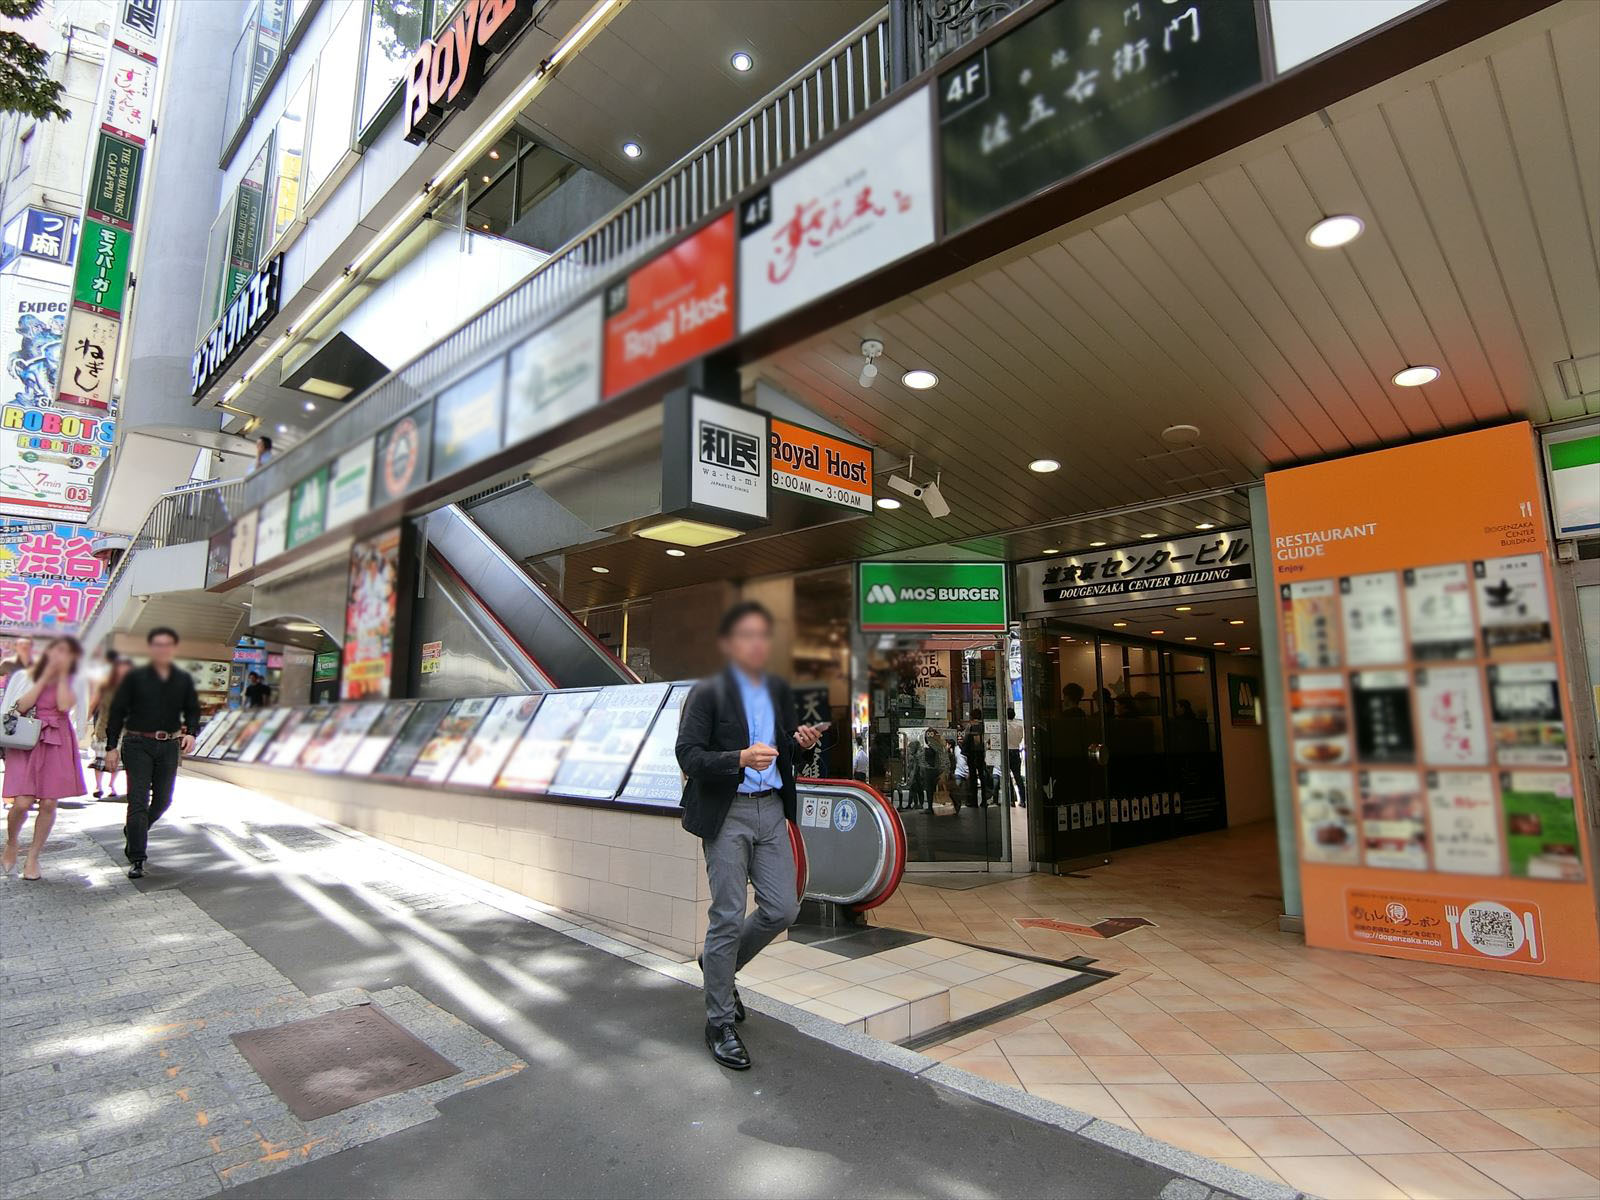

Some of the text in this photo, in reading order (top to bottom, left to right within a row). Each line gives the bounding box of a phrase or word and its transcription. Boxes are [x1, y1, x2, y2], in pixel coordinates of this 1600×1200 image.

[125, 0, 157, 36] 民
[947, 64, 980, 103] 4F
[121, 147, 132, 165] THE
[744, 197, 769, 226] 4F
[92, 228, 117, 304] モスバーガー
[91, 305, 104, 313] 1F
[74, 337, 105, 392] ねぎし
[18, 434, 71, 453] ROBOT
[702, 427, 757, 473] 和民
[771, 431, 868, 485] Royal Host
[36, 473, 49, 486] 7
[772, 472, 798, 487] 9:00
[800, 482, 811, 494] AM
[826, 485, 849, 503] 3:00
[850, 494, 861, 507] AM
[1276, 523, 1377, 548] RESTAURANT
[1484, 521, 1534, 534] DOGENZAKA
[1505, 528, 1535, 539] CENTER
[1277, 544, 1326, 561] GUIDE
[1501, 537, 1537, 547] BUILDING
[17, 534, 102, 578] 渋谷
[1042, 538, 1249, 585] 道玄坂センタービル
[20, 572, 98, 583] SHIBUYA
[1059, 568, 1231, 600] DOUGENZAKA CENTER BUILDING
[900, 588, 1000, 601] MOS BURGER
